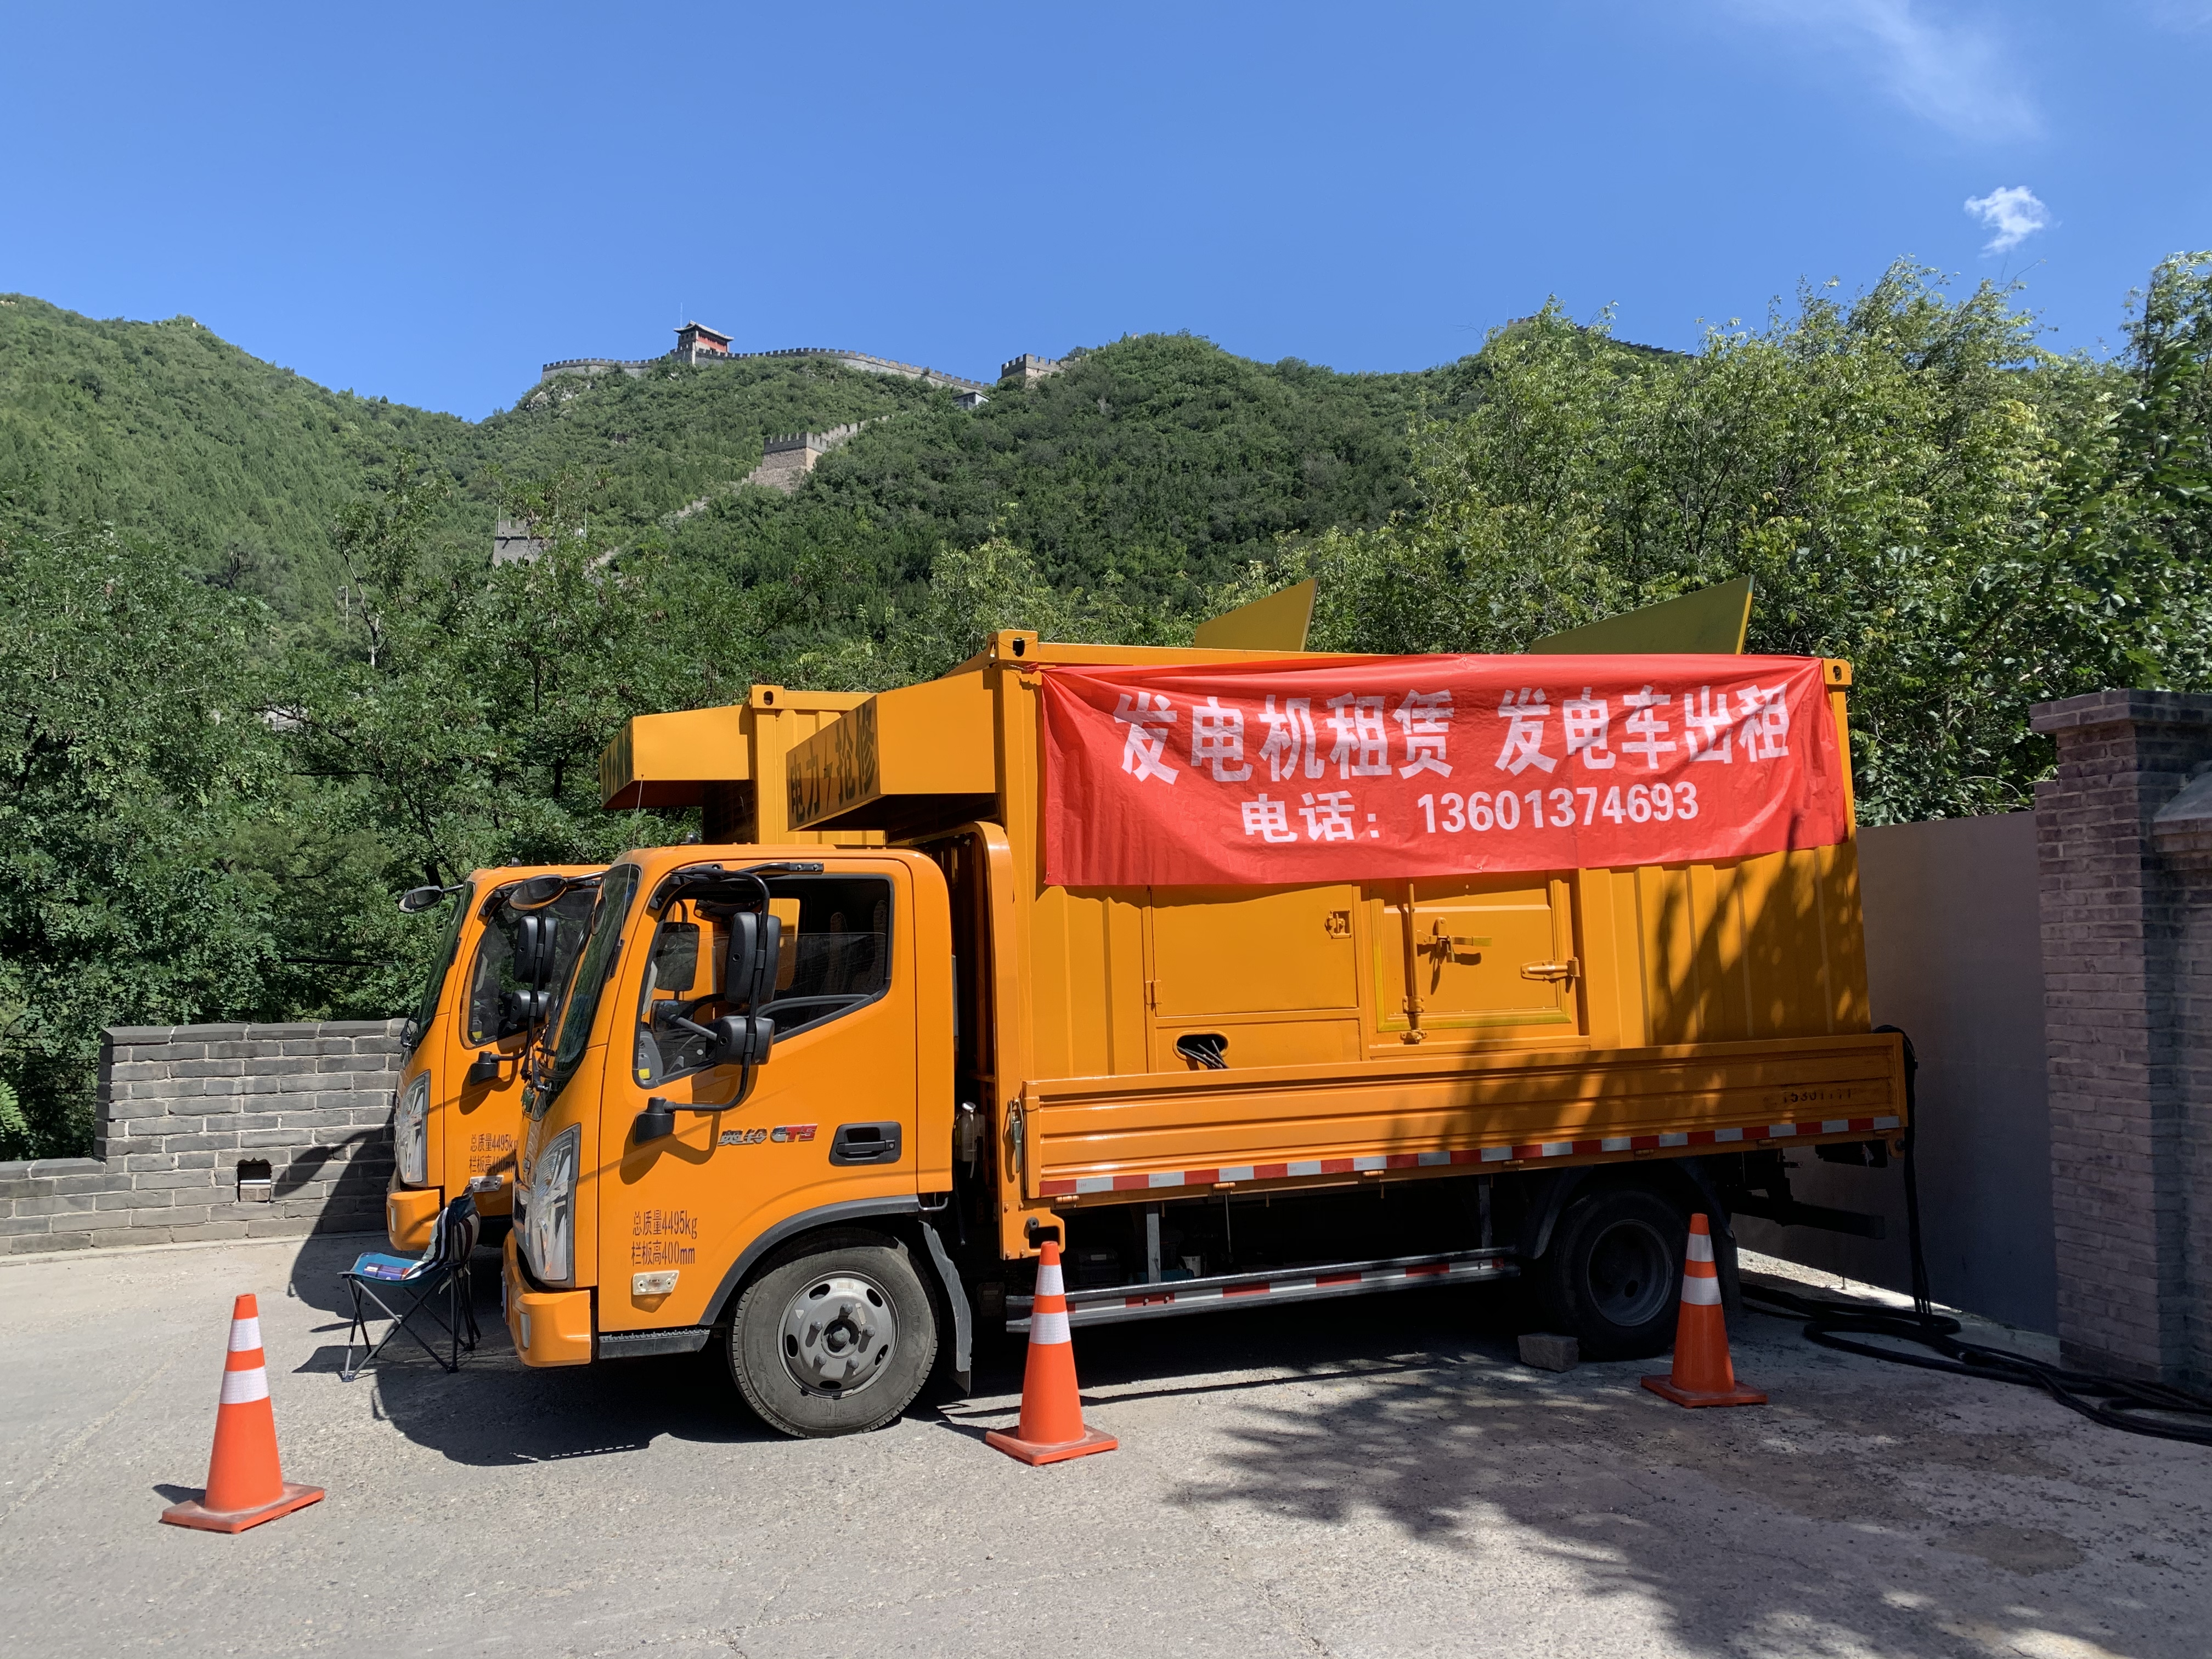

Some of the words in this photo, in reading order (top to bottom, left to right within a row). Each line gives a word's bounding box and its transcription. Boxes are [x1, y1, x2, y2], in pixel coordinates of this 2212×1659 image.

[1113, 689, 1455, 785] 发电机租赁
[1495, 682, 1790, 776] 发电车出租
[1417, 781, 1699, 833] 13601374693
[770, 1123, 818, 1143] CTS
[633, 1209, 698, 1239] 总质量4495kg
[631, 1239, 695, 1267] 栏板高400mm
